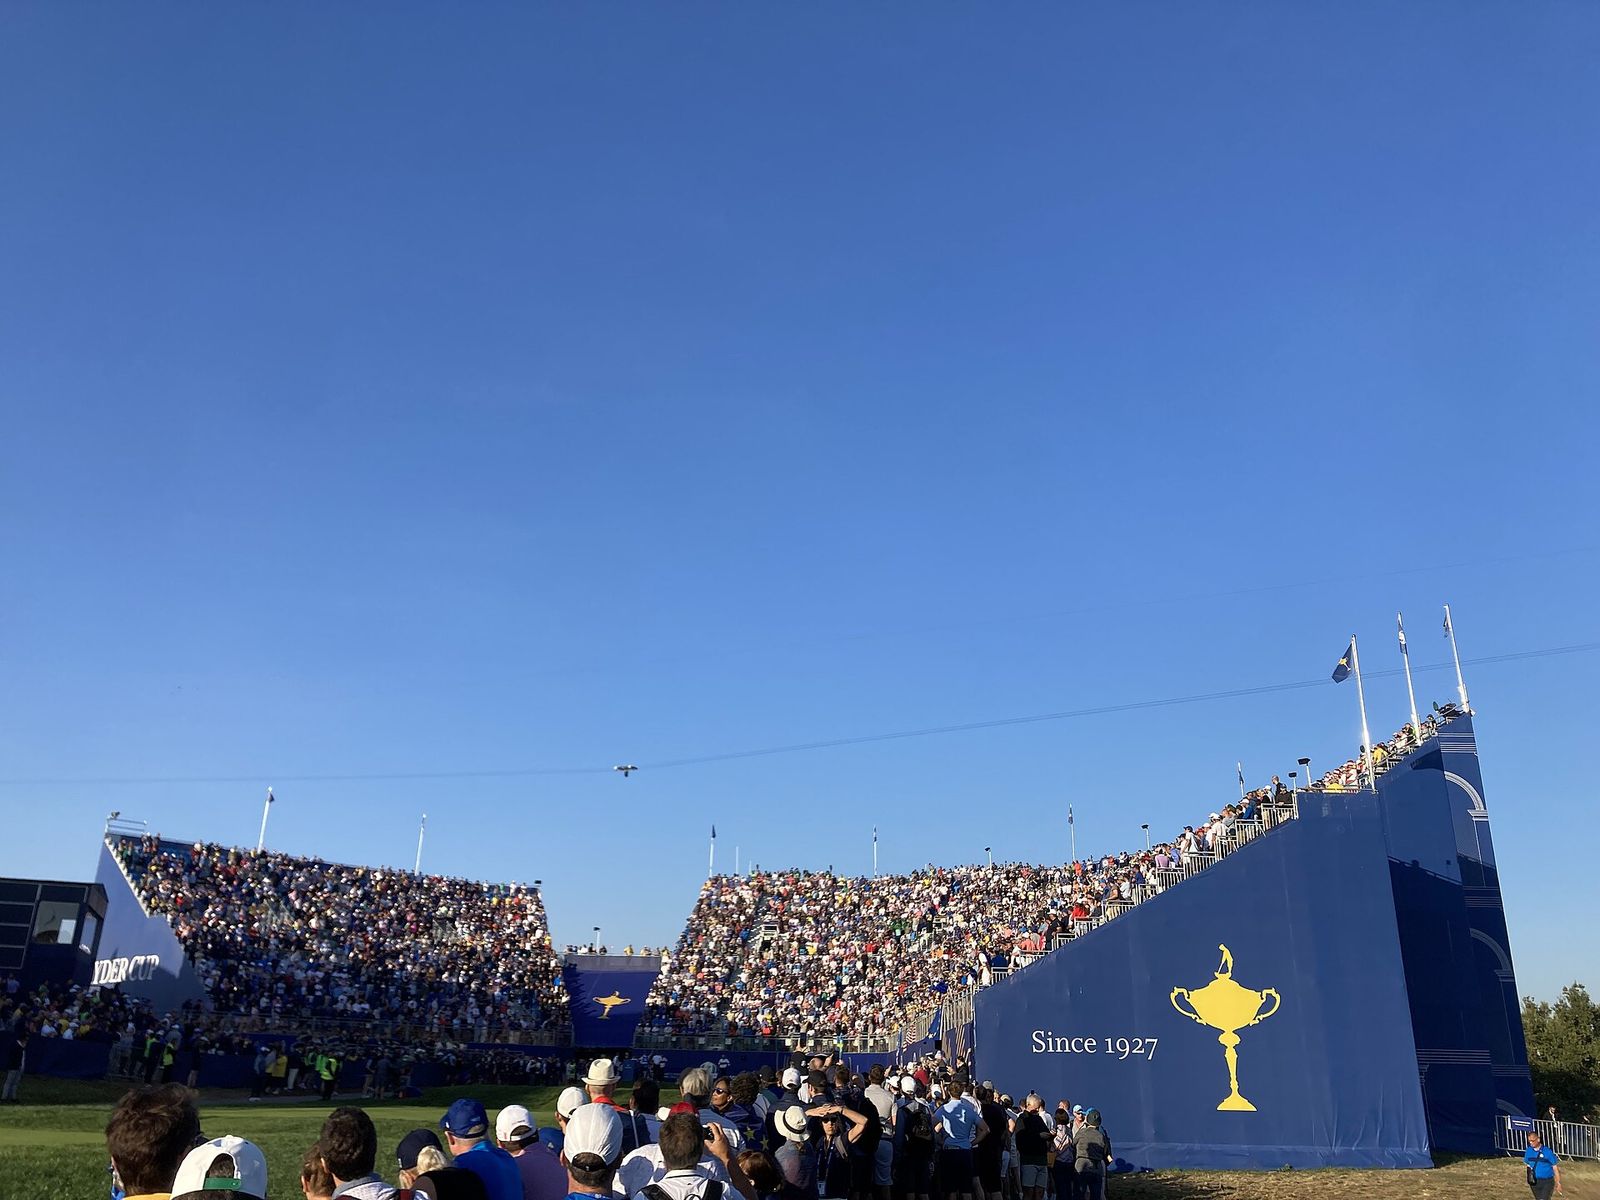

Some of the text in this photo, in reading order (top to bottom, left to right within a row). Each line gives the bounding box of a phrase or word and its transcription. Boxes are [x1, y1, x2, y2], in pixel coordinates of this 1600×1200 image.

[91, 955, 160, 985] YDER CUP
[1032, 1030, 1158, 1060] Since 1927
